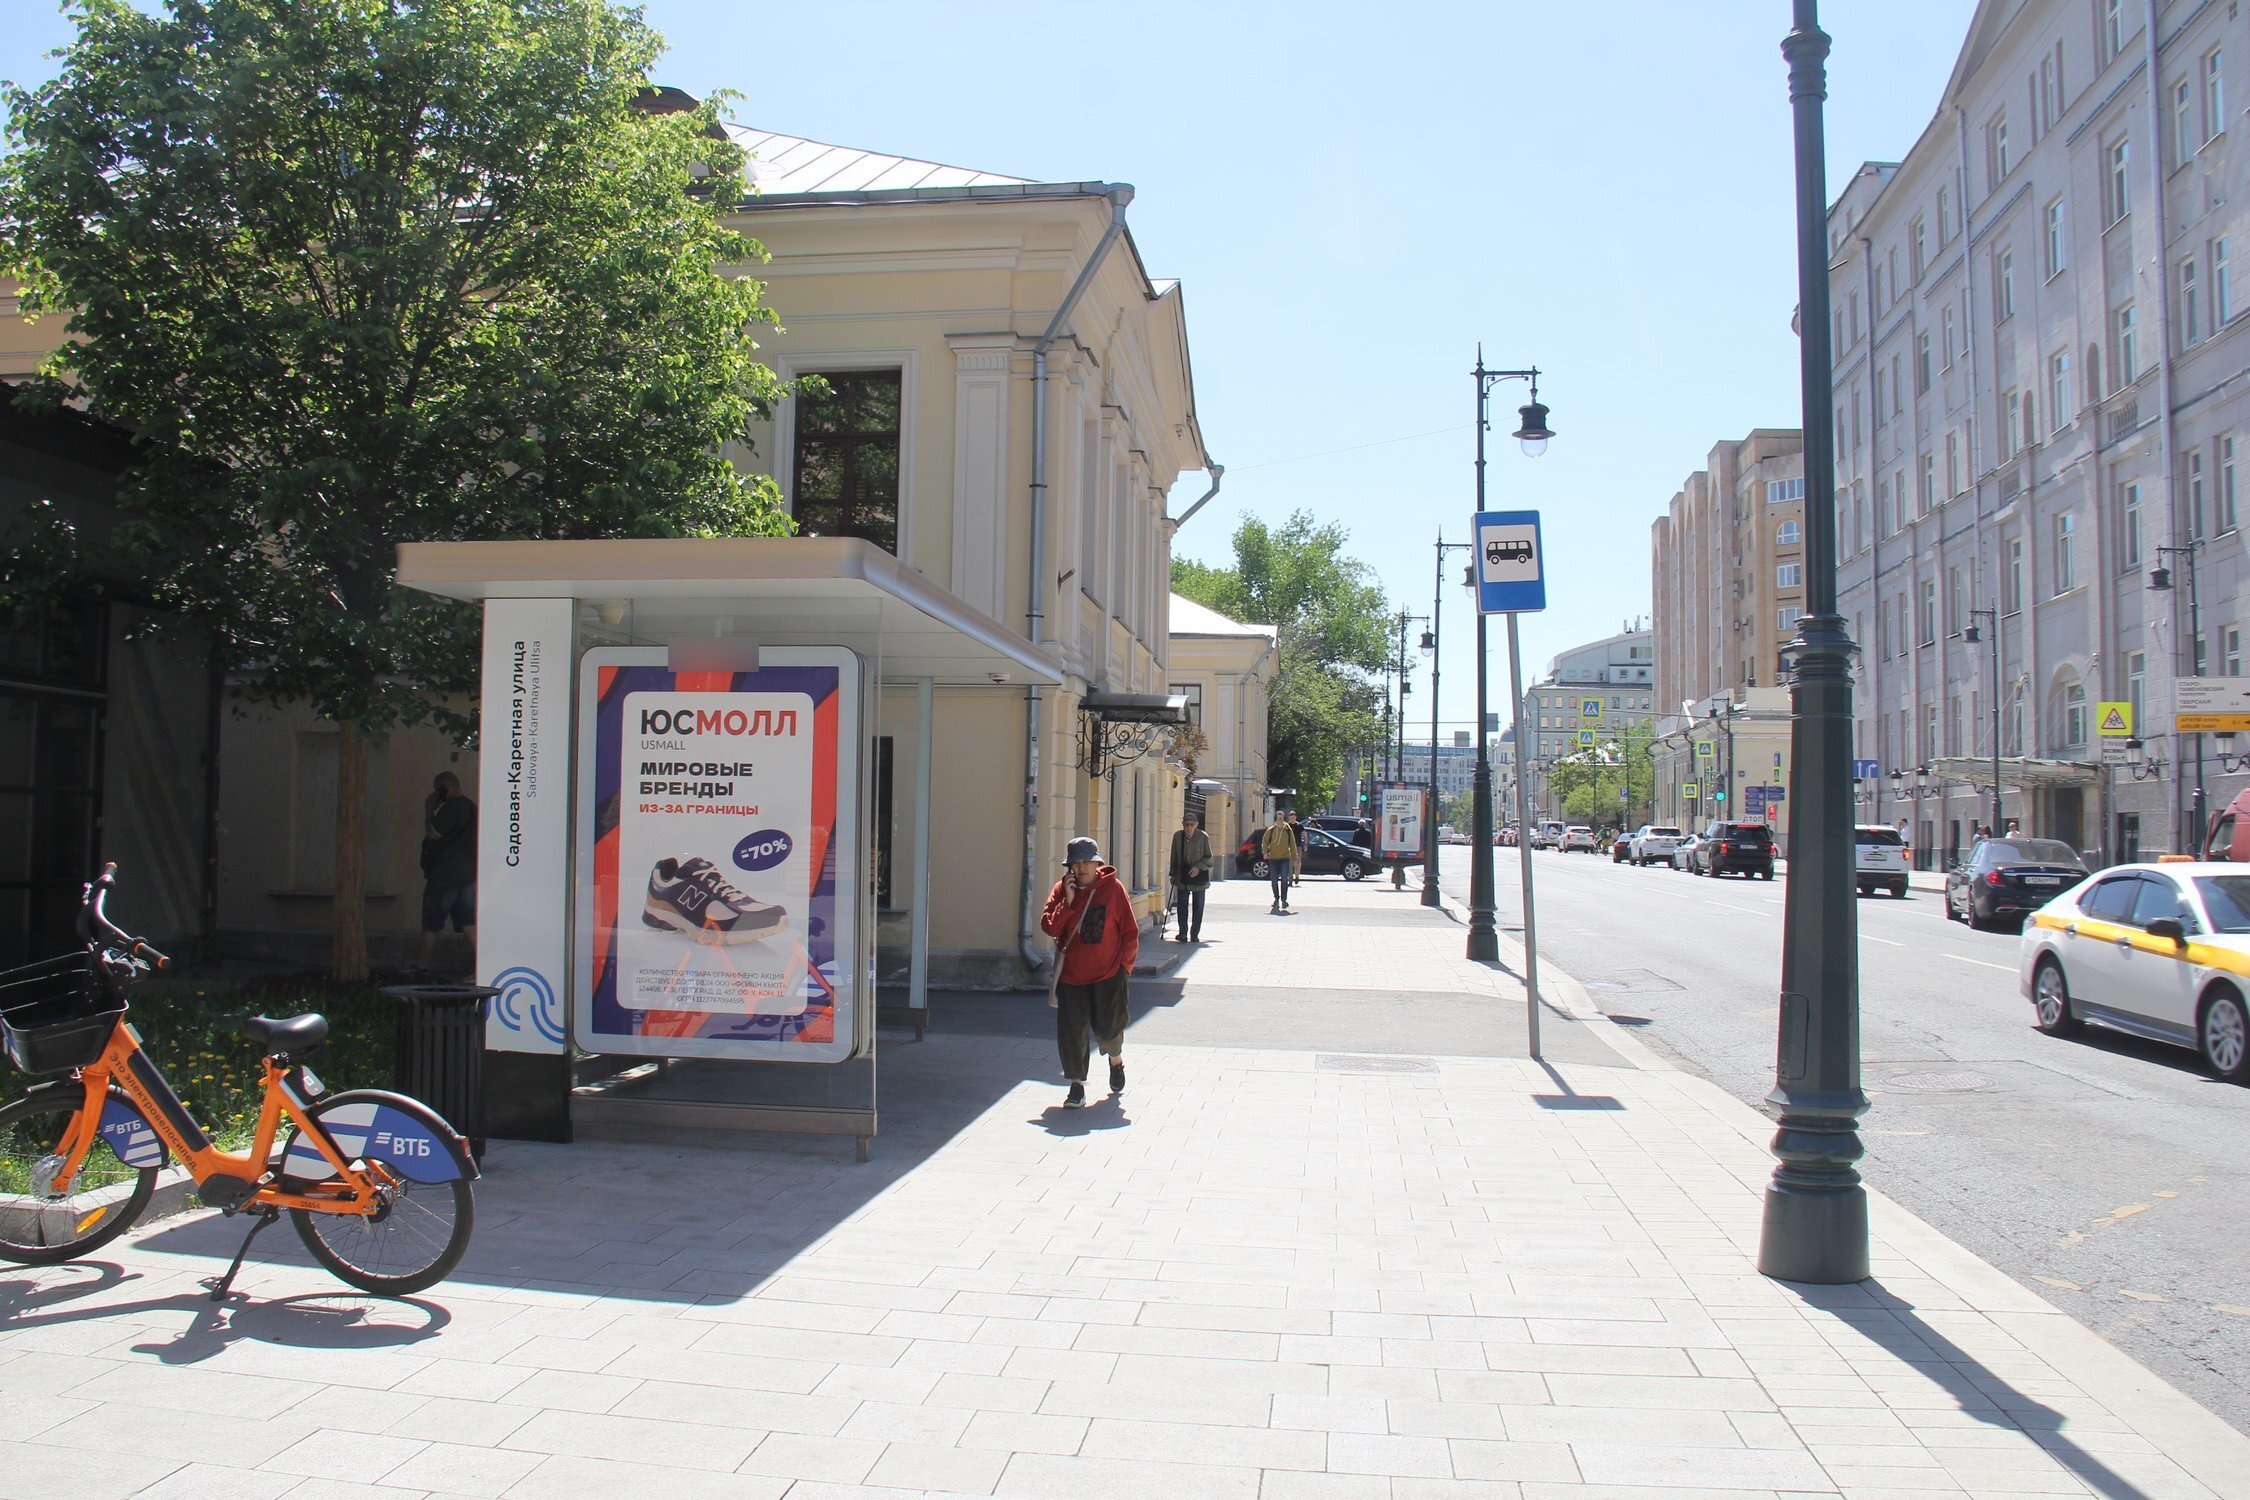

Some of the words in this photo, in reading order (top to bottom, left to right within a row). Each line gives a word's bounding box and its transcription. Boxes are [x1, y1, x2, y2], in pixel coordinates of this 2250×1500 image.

[530, 640, 541, 674] Ulitsa
[512, 640, 527, 694] улица
[640, 709, 797, 736] ЮСМОЛЛ
[527, 677, 541, 798] Sadovaya-Karetnaya
[641, 740, 687, 750] USMALL
[640, 762, 753, 777] МИРОВЫЕ
[505, 698, 524, 867] Садовая-Каретная
[639, 781, 734, 798] БРЕНДЫ
[1386, 793, 1418, 801] usmall
[639, 804, 684, 814] ИЗ-ЗА
[686, 805, 759, 817] ГРАНИЦЫ
[638, 969, 685, 977] КОЛИЧЕСТВО
[760, 973, 785, 981] АКЦИЯ
[116, 1119, 142, 1135] ВТБ
[393, 1137, 431, 1157] ВТБ
